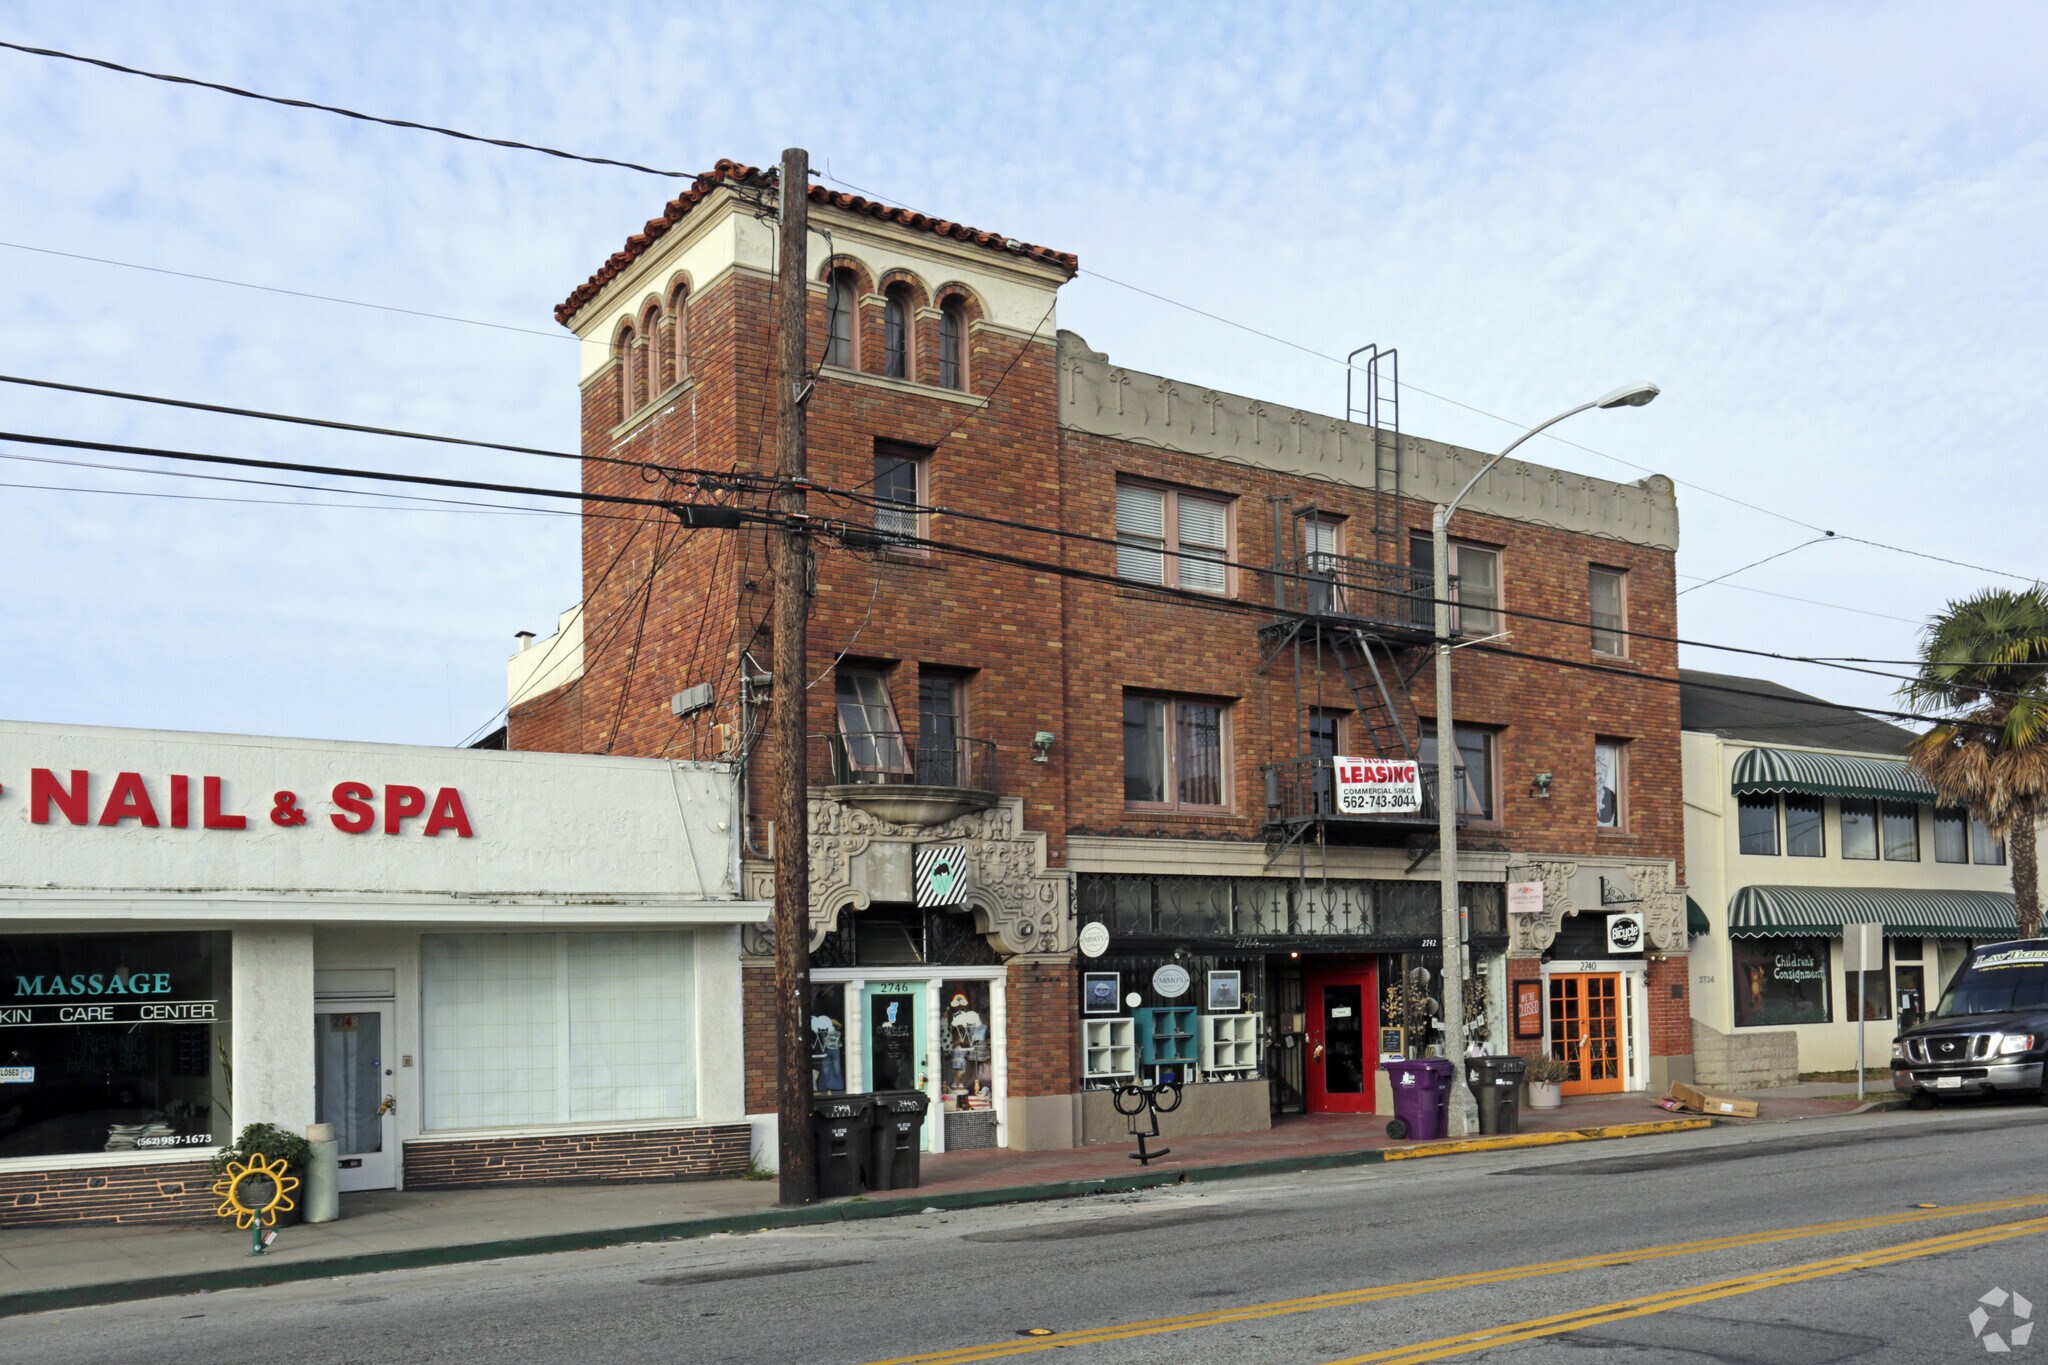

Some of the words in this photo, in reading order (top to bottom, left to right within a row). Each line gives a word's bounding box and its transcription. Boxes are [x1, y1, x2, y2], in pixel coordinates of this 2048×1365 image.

[1340, 766, 1415, 784] LEASING
[31, 768, 247, 830] NAIL
[270, 790, 307, 827] &
[330, 781, 474, 838] SPA
[1343, 795, 1417, 808] 562-743-3044
[1612, 923, 1639, 941] Bicycle
[1579, 961, 1597, 971] 2740
[1775, 953, 1814, 967] Children's
[1160, 976, 1184, 984] MIMO'S
[1773, 967, 1825, 983] Consignment
[14, 973, 172, 996] MASSAGE
[880, 982, 909, 992] 2746
[0, 1009, 32, 1024] KIN
[59, 1006, 114, 1021] CARE
[140, 1004, 215, 1020] CENTER
[0, 1068, 19, 1077] LOSED
